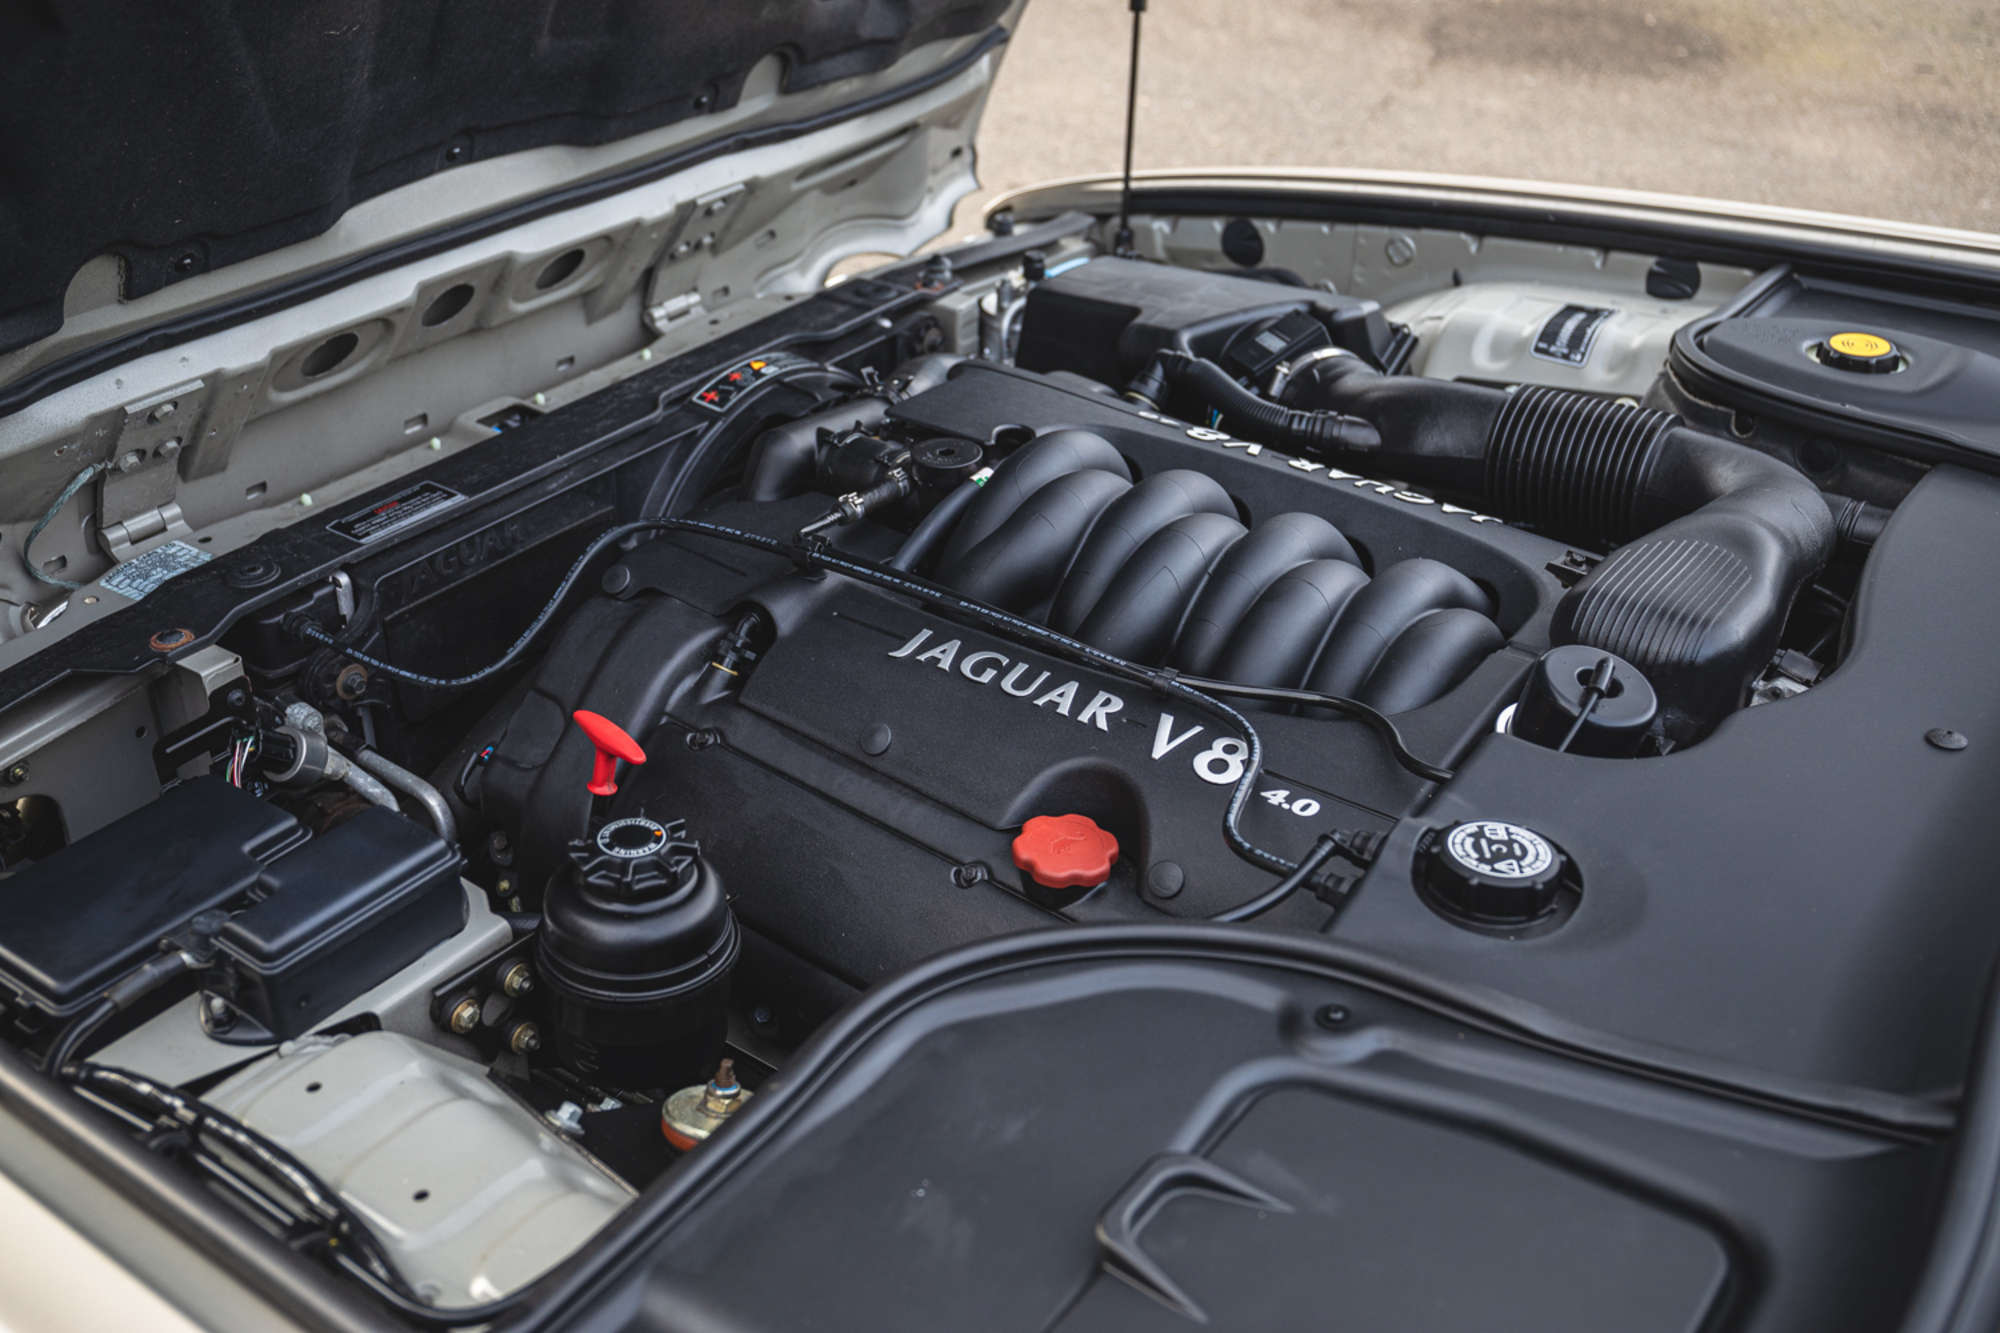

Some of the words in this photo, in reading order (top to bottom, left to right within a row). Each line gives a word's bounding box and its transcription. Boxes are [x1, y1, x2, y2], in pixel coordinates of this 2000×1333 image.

[888, 627, 1124, 733] JAGUAR
[1150, 712, 1249, 785] V8
[1258, 788, 1321, 817] 4.0
